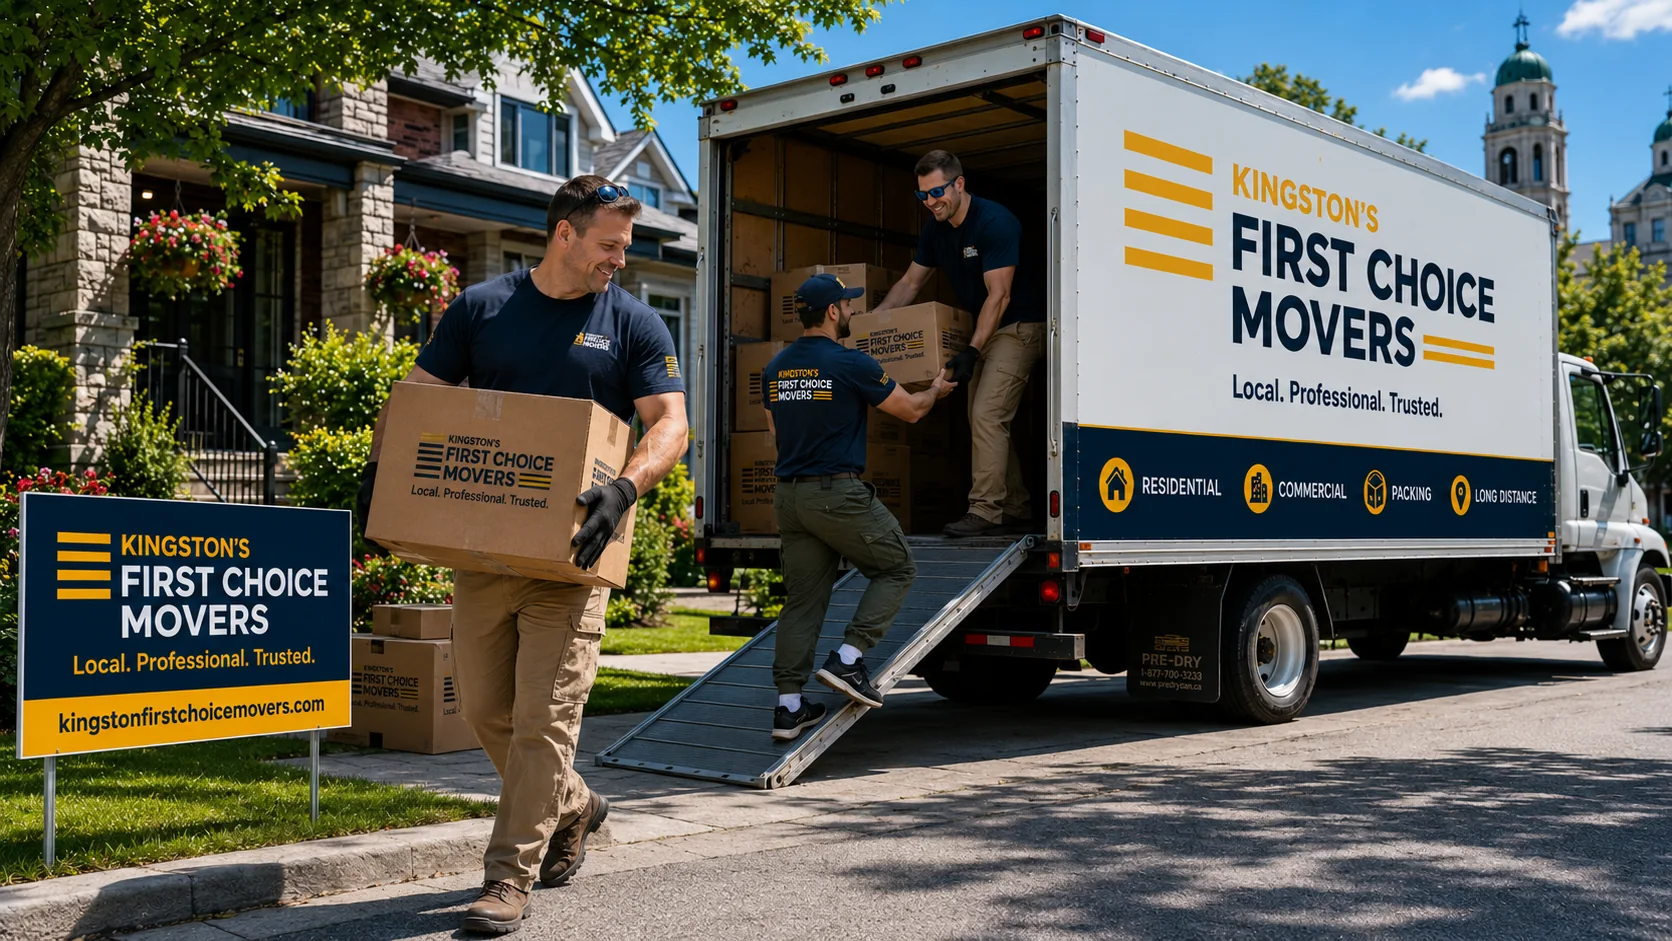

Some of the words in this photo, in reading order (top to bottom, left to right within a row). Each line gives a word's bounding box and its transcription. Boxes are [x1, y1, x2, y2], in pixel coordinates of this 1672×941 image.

[1232, 163, 1379, 233] KINGSTON'S
[1232, 212, 1355, 292] FIRST
[1367, 248, 1495, 324] CHOICE
[893, 330, 923, 342] CHOICE
[1232, 285, 1415, 367] MOVERS
[871, 343, 906, 356] MOVERS
[778, 379, 798, 390] FIRST
[800, 379, 832, 389] CHOICE
[778, 390, 812, 401] MOVERS
[1233, 374, 1284, 402] Local.
[1290, 380, 1385, 412] Professional.
[1389, 392, 1443, 418] Trusted.
[448, 435, 500, 448] KINGSTON'S
[446, 447, 491, 465] FIRST
[493, 451, 555, 472] CHOICE
[443, 465, 515, 487] MOVERS
[1142, 476, 1222, 496] RESIDENTIAL
[411, 485, 440, 498] Local.
[443, 488, 507, 505] Professional.
[510, 494, 549, 509] Trusted.
[1278, 481, 1347, 499] COMMERCIAL
[1391, 485, 1432, 501] PACKING
[1475, 489, 1498, 503] LONG
[1500, 490, 1537, 504] DISTANCE
[121, 534, 250, 558] KINGSTON'S
[121, 565, 215, 597] FIRST
[222, 568, 328, 597] CHOICE
[121, 603, 269, 638] MOVERS
[73, 653, 131, 675] Local.
[137, 649, 249, 672] Professional.
[253, 646, 316, 667] Trusted.
[1142, 653, 1202, 668] PRE-DRY
[363, 673, 386, 685] FIRST
[387, 675, 419, 688] CHOICE
[362, 686, 400, 698] MOVERS
[58, 698, 325, 735] kingstonfirstchoicemovers.com
